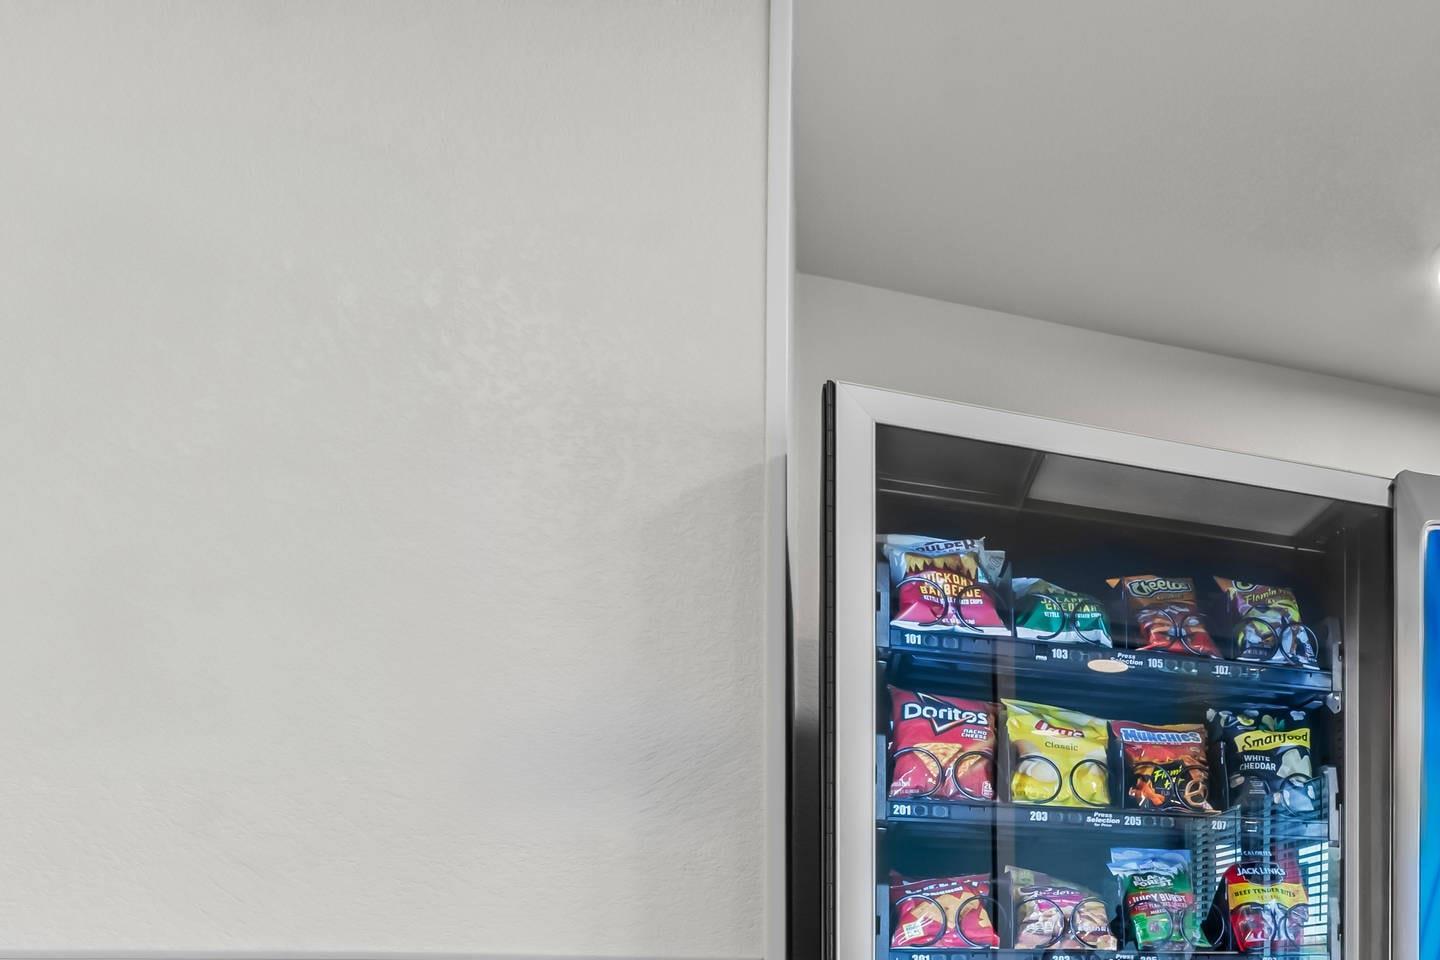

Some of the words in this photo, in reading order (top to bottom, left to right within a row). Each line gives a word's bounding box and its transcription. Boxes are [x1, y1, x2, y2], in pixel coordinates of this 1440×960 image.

[904, 633, 922, 645] 101
[1052, 648, 1069, 659] 103
[1148, 658, 1164, 668] 105
[903, 703, 988, 725] Doritos
[1044, 741, 1079, 752] Classic
[893, 804, 912, 816] 201
[1029, 811, 1048, 822] 203
[1086, 816, 1121, 824] Selection
[1124, 815, 1142, 826] 205
[1211, 820, 1227, 830] 207
